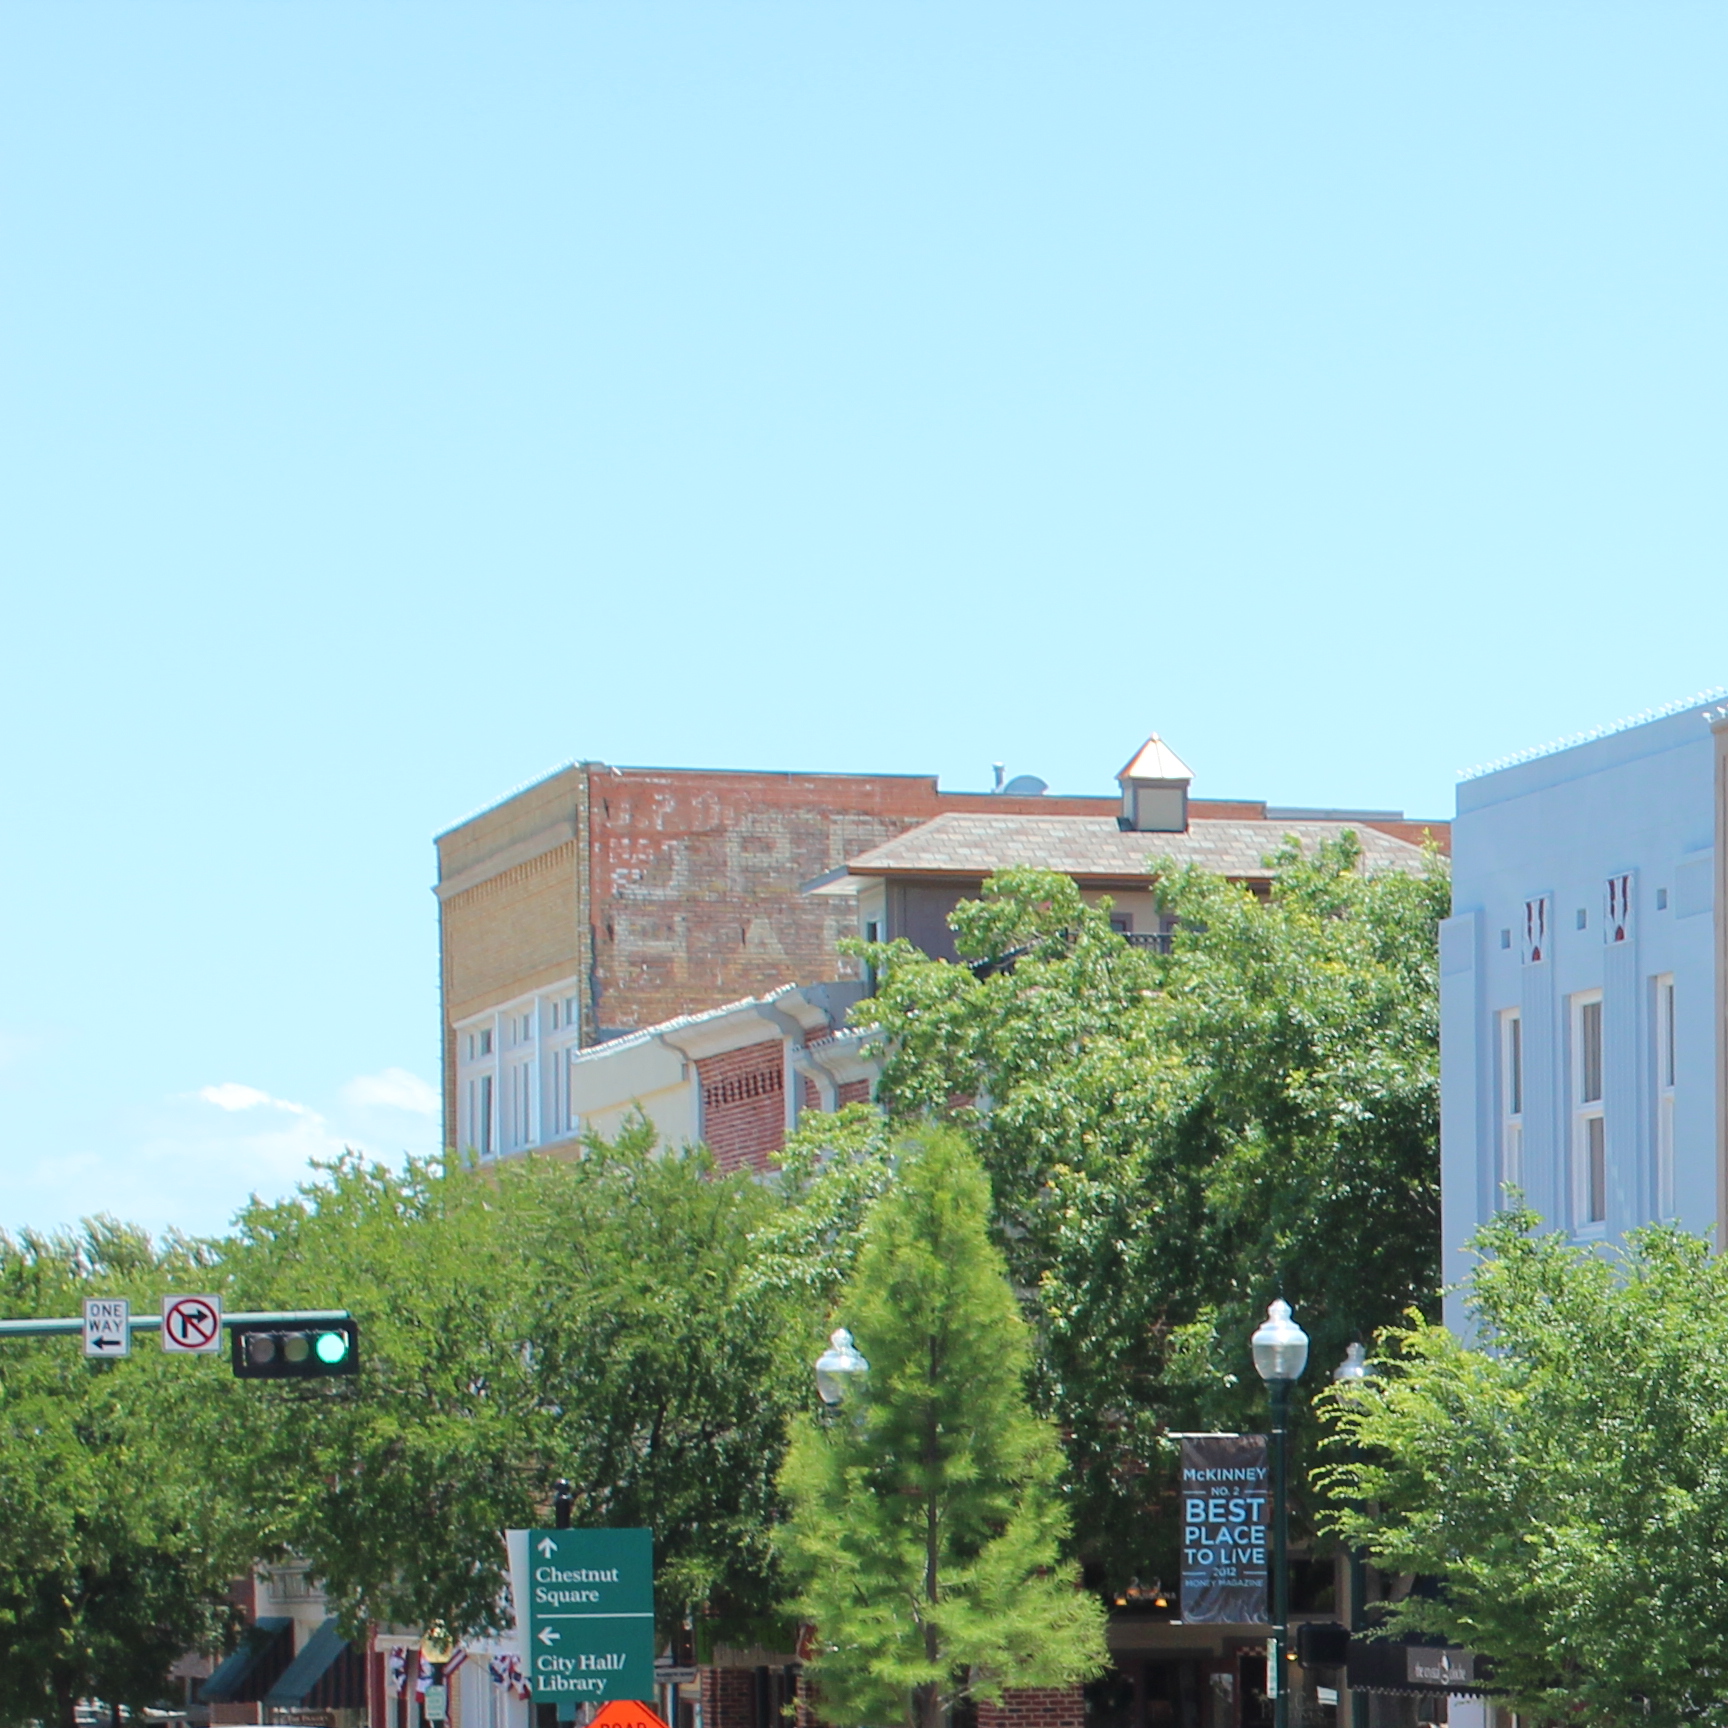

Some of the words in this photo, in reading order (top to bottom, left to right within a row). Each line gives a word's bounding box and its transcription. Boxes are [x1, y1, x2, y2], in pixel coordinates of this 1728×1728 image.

[91, 1304, 122, 1317] ONE
[89, 1320, 122, 1333] WAY
[1183, 1467, 1267, 1482] McKINNEY
[1211, 1486, 1230, 1496] NO.
[1233, 1486, 1240, 1496] 2
[1186, 1498, 1265, 1523] BEST
[1185, 1525, 1265, 1545] PLACE
[1184, 1548, 1214, 1565] TO
[1220, 1548, 1265, 1564] LIVE
[535, 1567, 619, 1583] Chestnut
[1213, 1567, 1237, 1577] 2012
[1185, 1579, 1216, 1588] MONEY
[1219, 1579, 1264, 1588] MAGAZINE
[536, 1587, 600, 1607] Square
[537, 1655, 575, 1674] City
[579, 1653, 626, 1671] Hall/
[537, 1675, 607, 1694] Library
